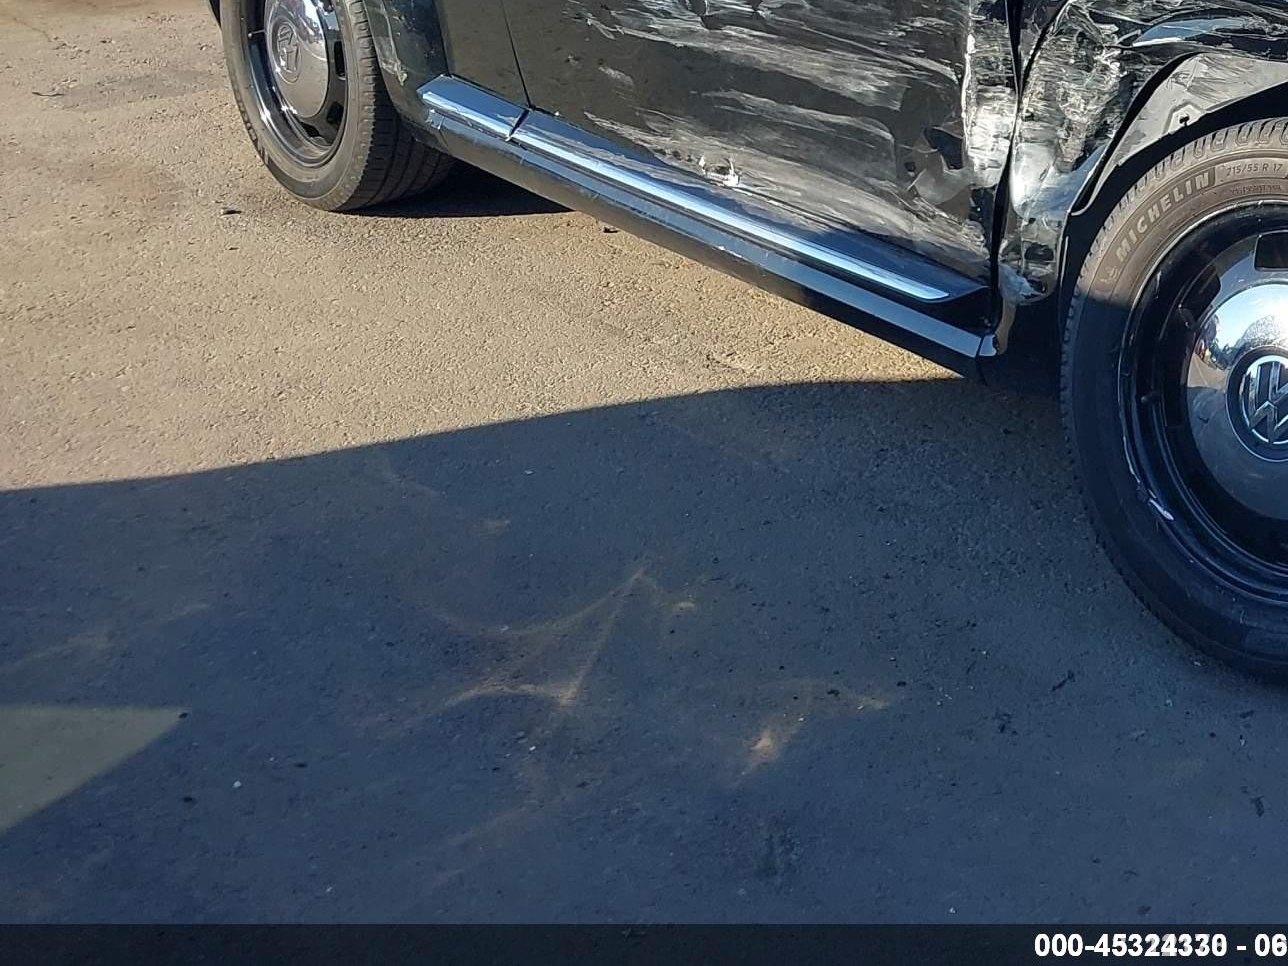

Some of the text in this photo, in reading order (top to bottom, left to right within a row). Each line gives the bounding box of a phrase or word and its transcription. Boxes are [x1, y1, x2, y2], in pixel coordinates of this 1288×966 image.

[1262, 163, 1269, 172] R
[1273, 163, 1283, 172] 17
[1117, 172, 1209, 262] MICHELIN
